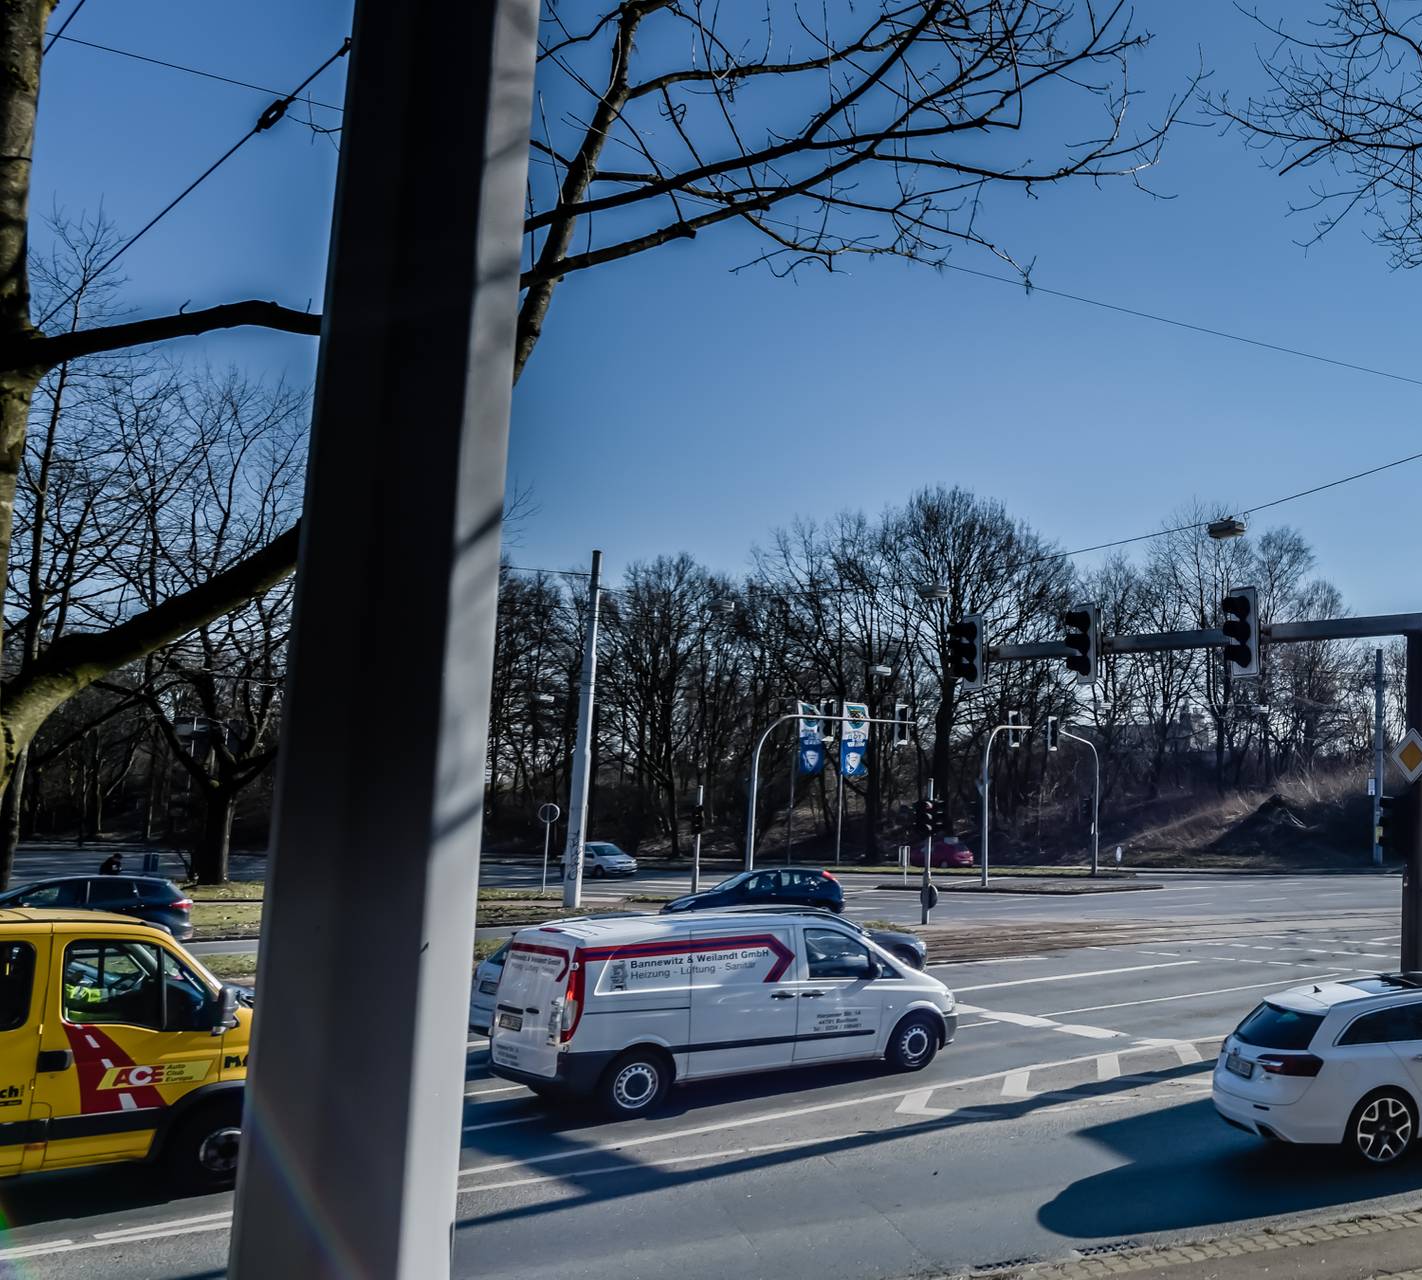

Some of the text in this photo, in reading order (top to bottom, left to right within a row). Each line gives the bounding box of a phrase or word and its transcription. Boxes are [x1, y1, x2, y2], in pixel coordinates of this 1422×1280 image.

[630, 949, 769, 969] Bannewitz & Weilandt GmbH
[630, 969, 671, 981] Heizung
[680, 964, 716, 976] Lüftung
[725, 961, 756, 972] Sanitär
[112, 1065, 165, 1087] ACE
